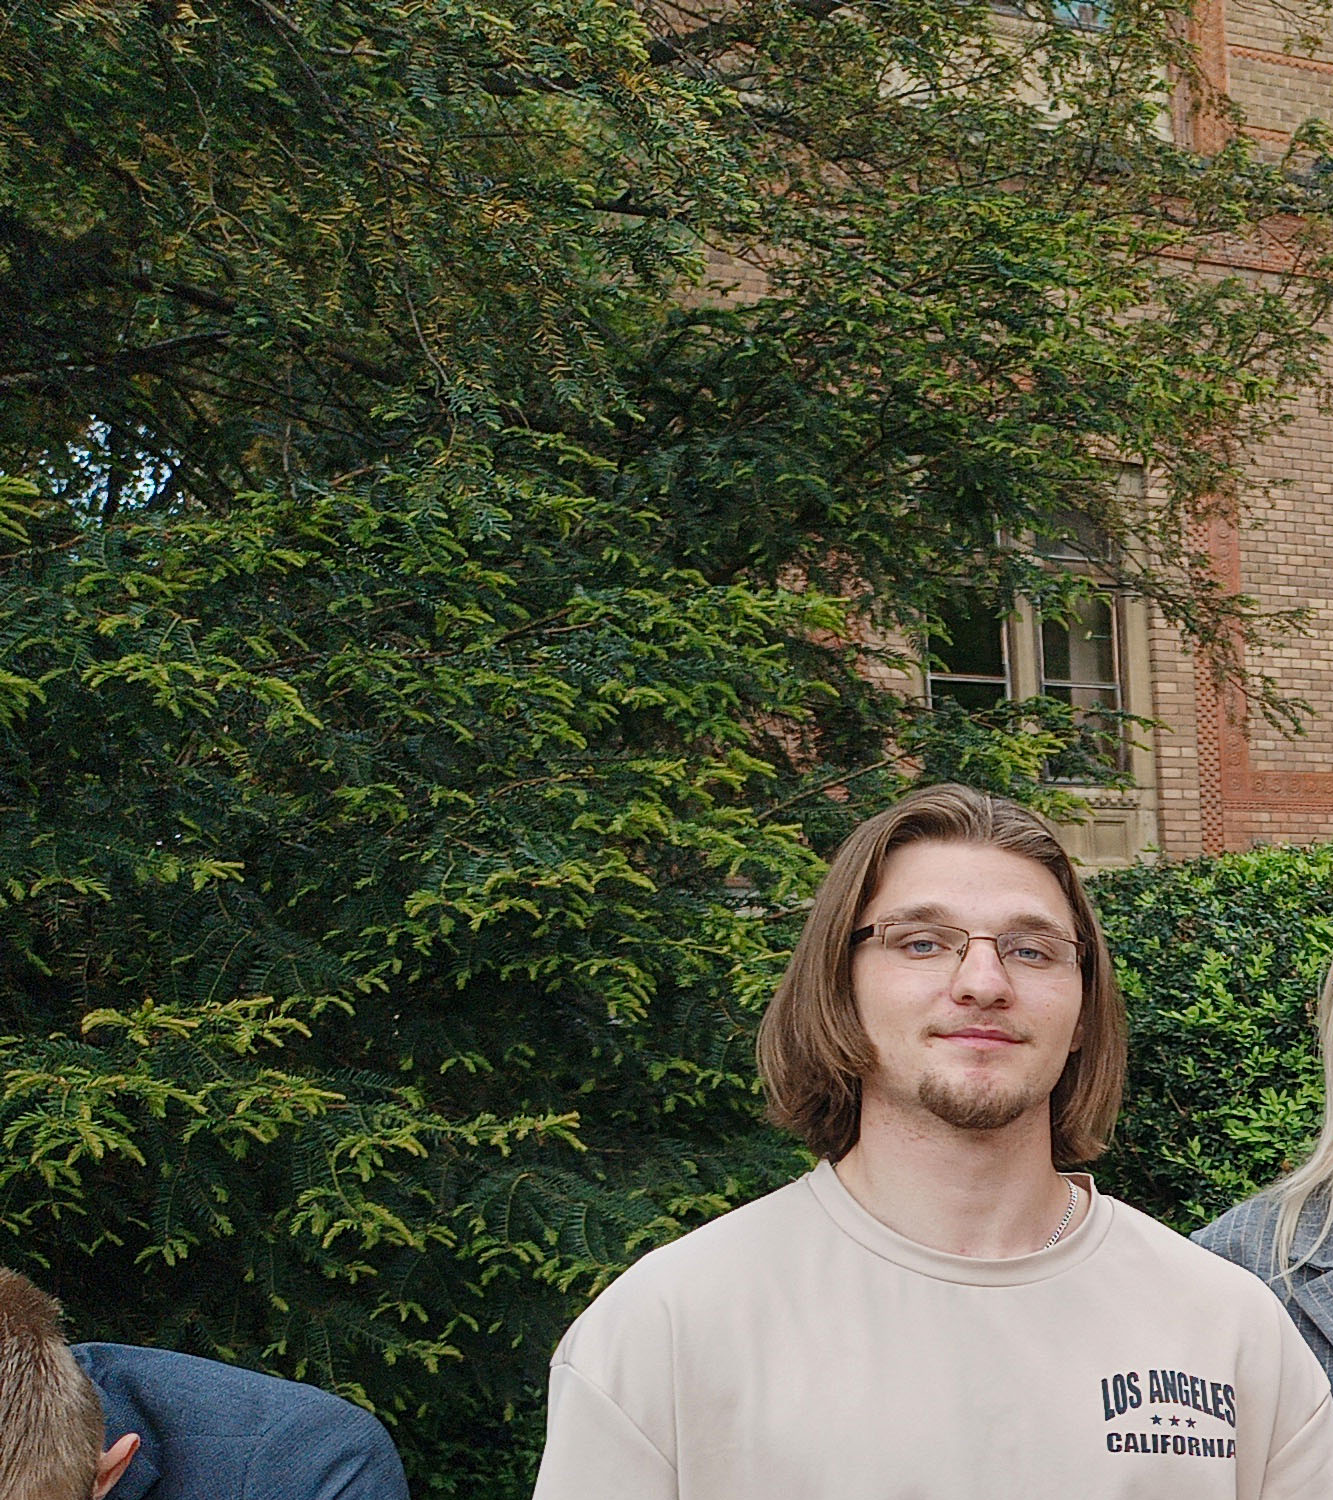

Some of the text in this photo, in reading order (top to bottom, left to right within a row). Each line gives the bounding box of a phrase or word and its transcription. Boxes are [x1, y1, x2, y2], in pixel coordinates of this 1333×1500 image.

[1101, 1370, 1236, 1428] LOS ANGELES
[1107, 1433, 1236, 1459] CALIFORNIA
